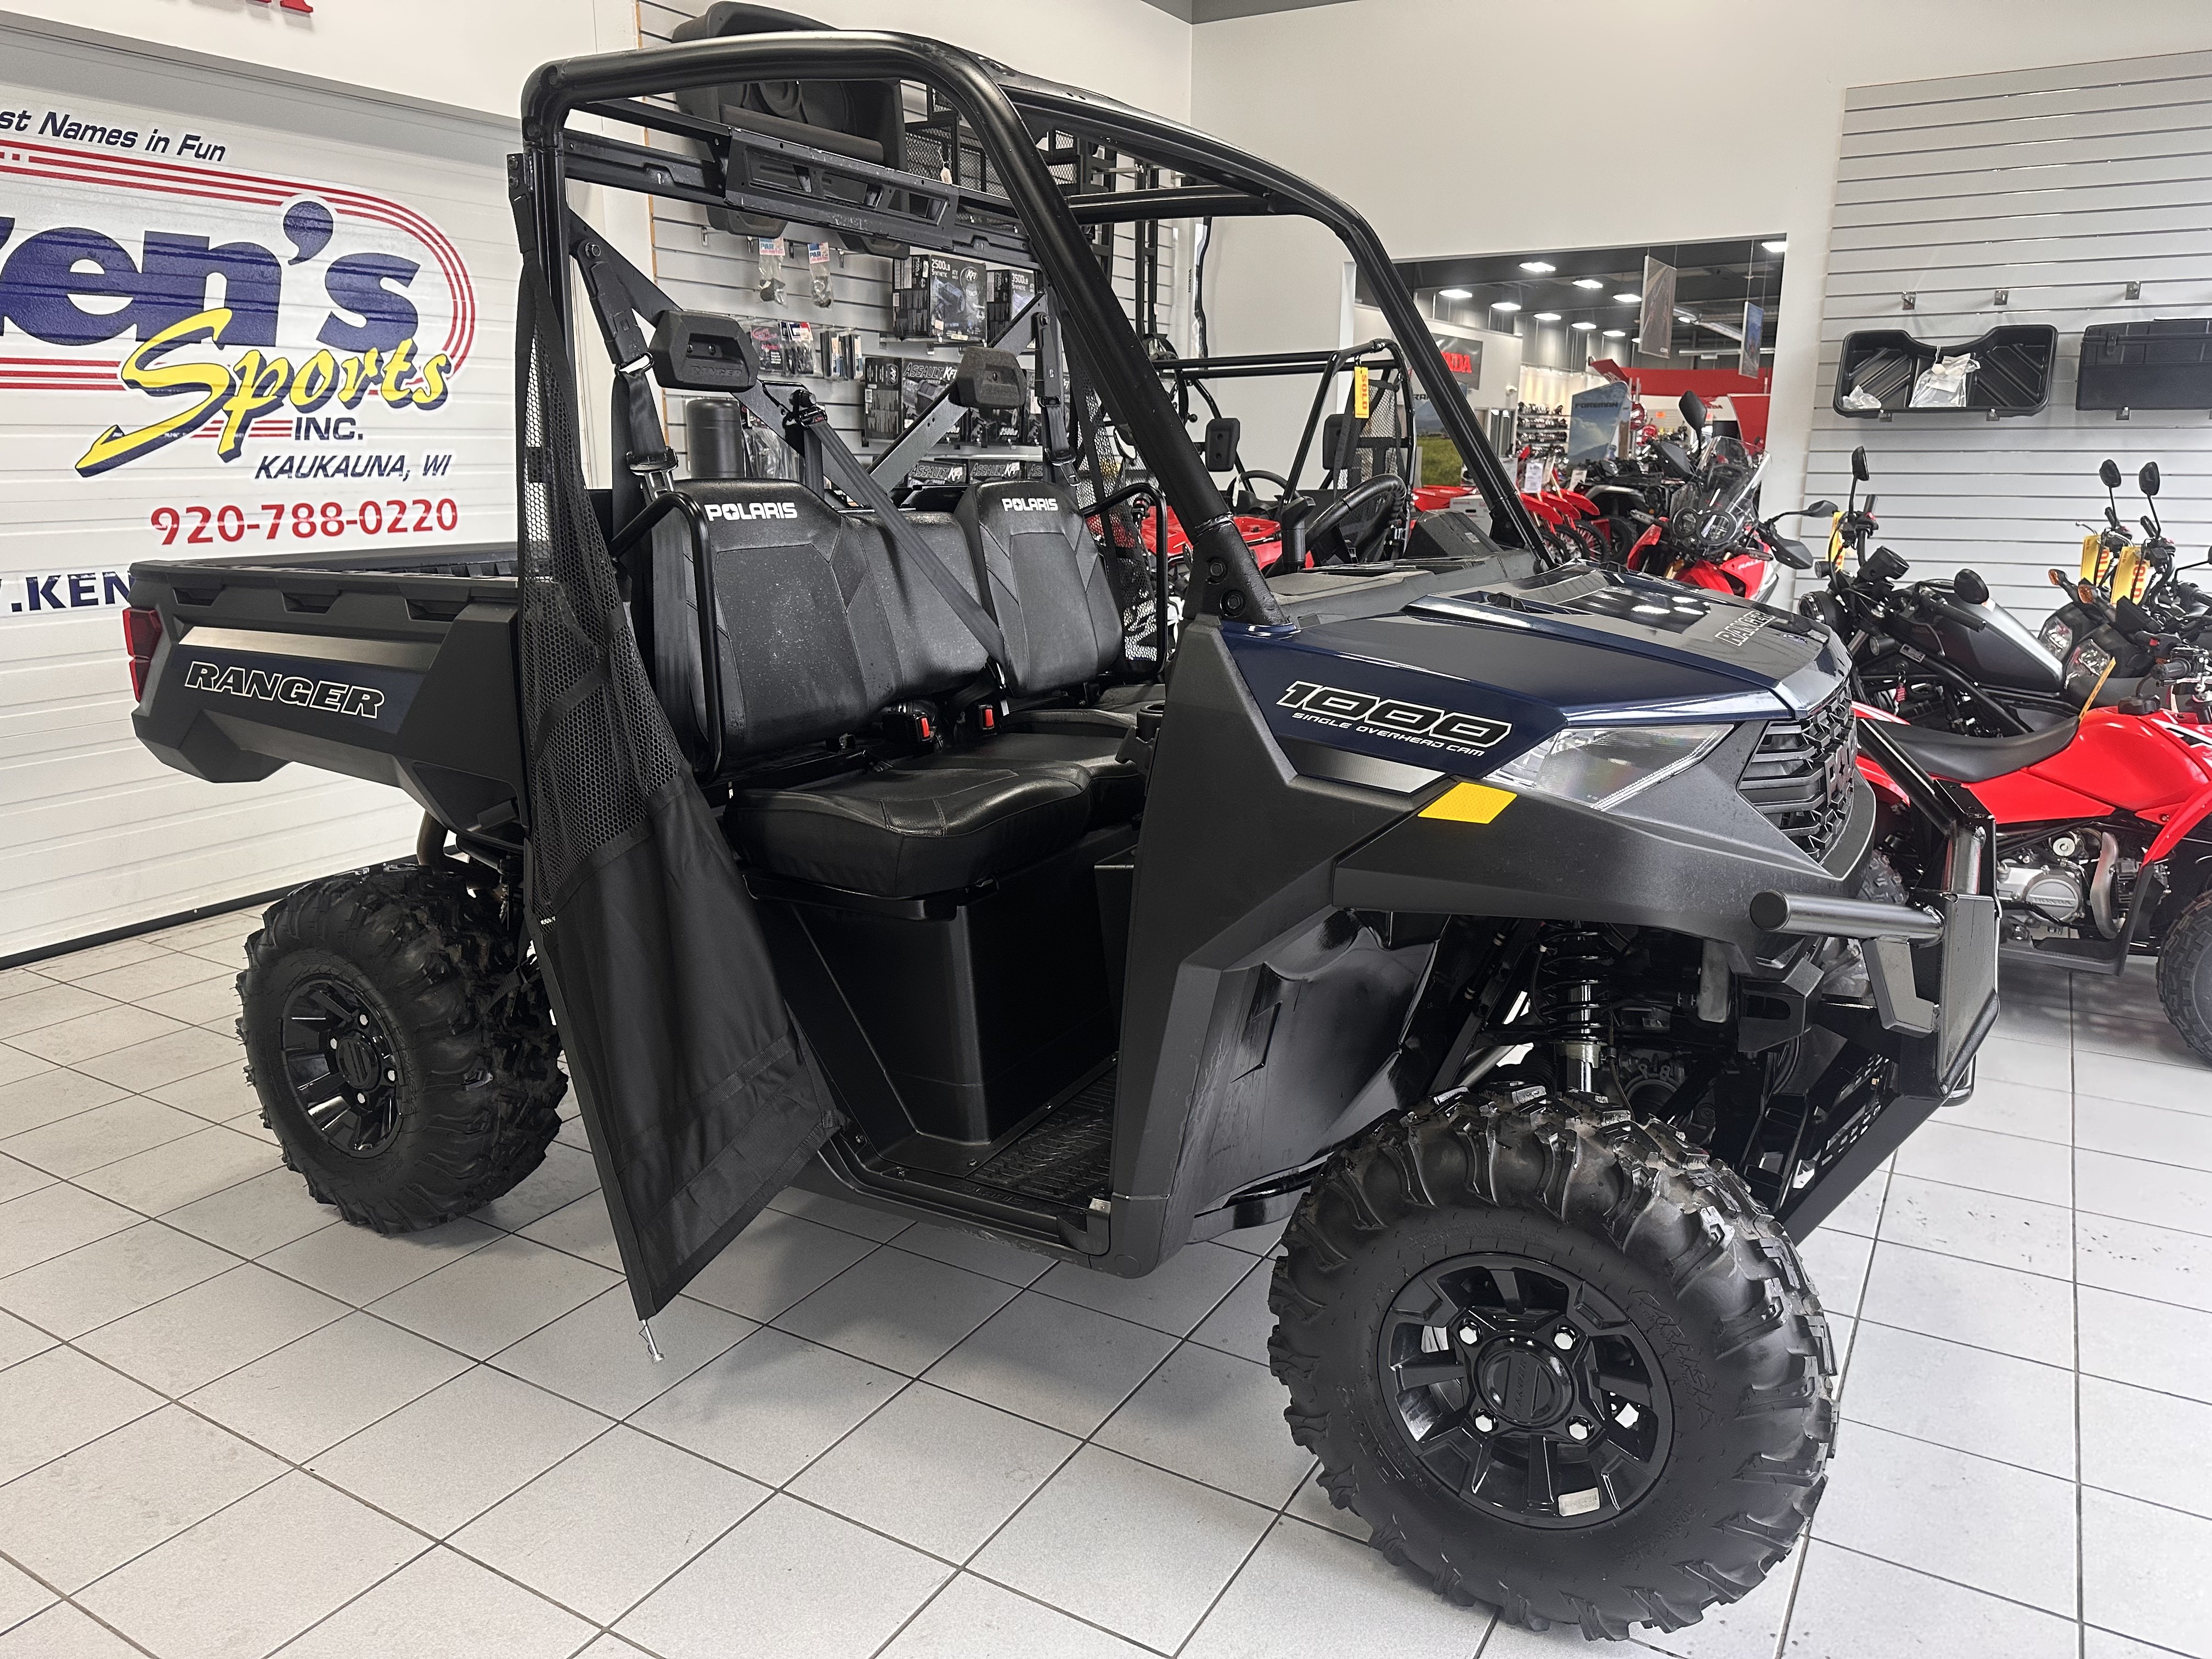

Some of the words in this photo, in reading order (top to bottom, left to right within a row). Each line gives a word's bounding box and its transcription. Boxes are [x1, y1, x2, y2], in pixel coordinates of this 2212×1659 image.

[38, 112, 137, 149] Names
[145, 136, 171, 154] in
[177, 134, 225, 162] Fun
[0, 201, 420, 352] en's
[932, 259, 951, 271] 2500LB
[1012, 273, 1029, 285] 3500LB
[691, 365, 742, 377] RANGER
[904, 362, 944, 379] ASSAULT
[1440, 351, 1472, 374] NDA
[75, 308, 454, 477] Sports
[295, 417, 363, 441] INC.
[255, 454, 410, 481] KAUKAUNA,
[422, 455, 453, 477] WI
[909, 464, 949, 479] ASSAULT
[970, 462, 1006, 477] ASSAULT
[706, 502, 798, 521] POLARIS
[1002, 498, 1059, 512] POLARIS
[151, 498, 459, 545] 920-788-0220
[0, 571, 136, 613] .KEN
[184, 661, 385, 719] RANGER
[1276, 680, 1513, 748] 1000
[1291, 712, 1352, 730] SINGLE
[1356, 725, 1444, 748] OVERHEAD
[1446, 744, 1485, 757] CAM
